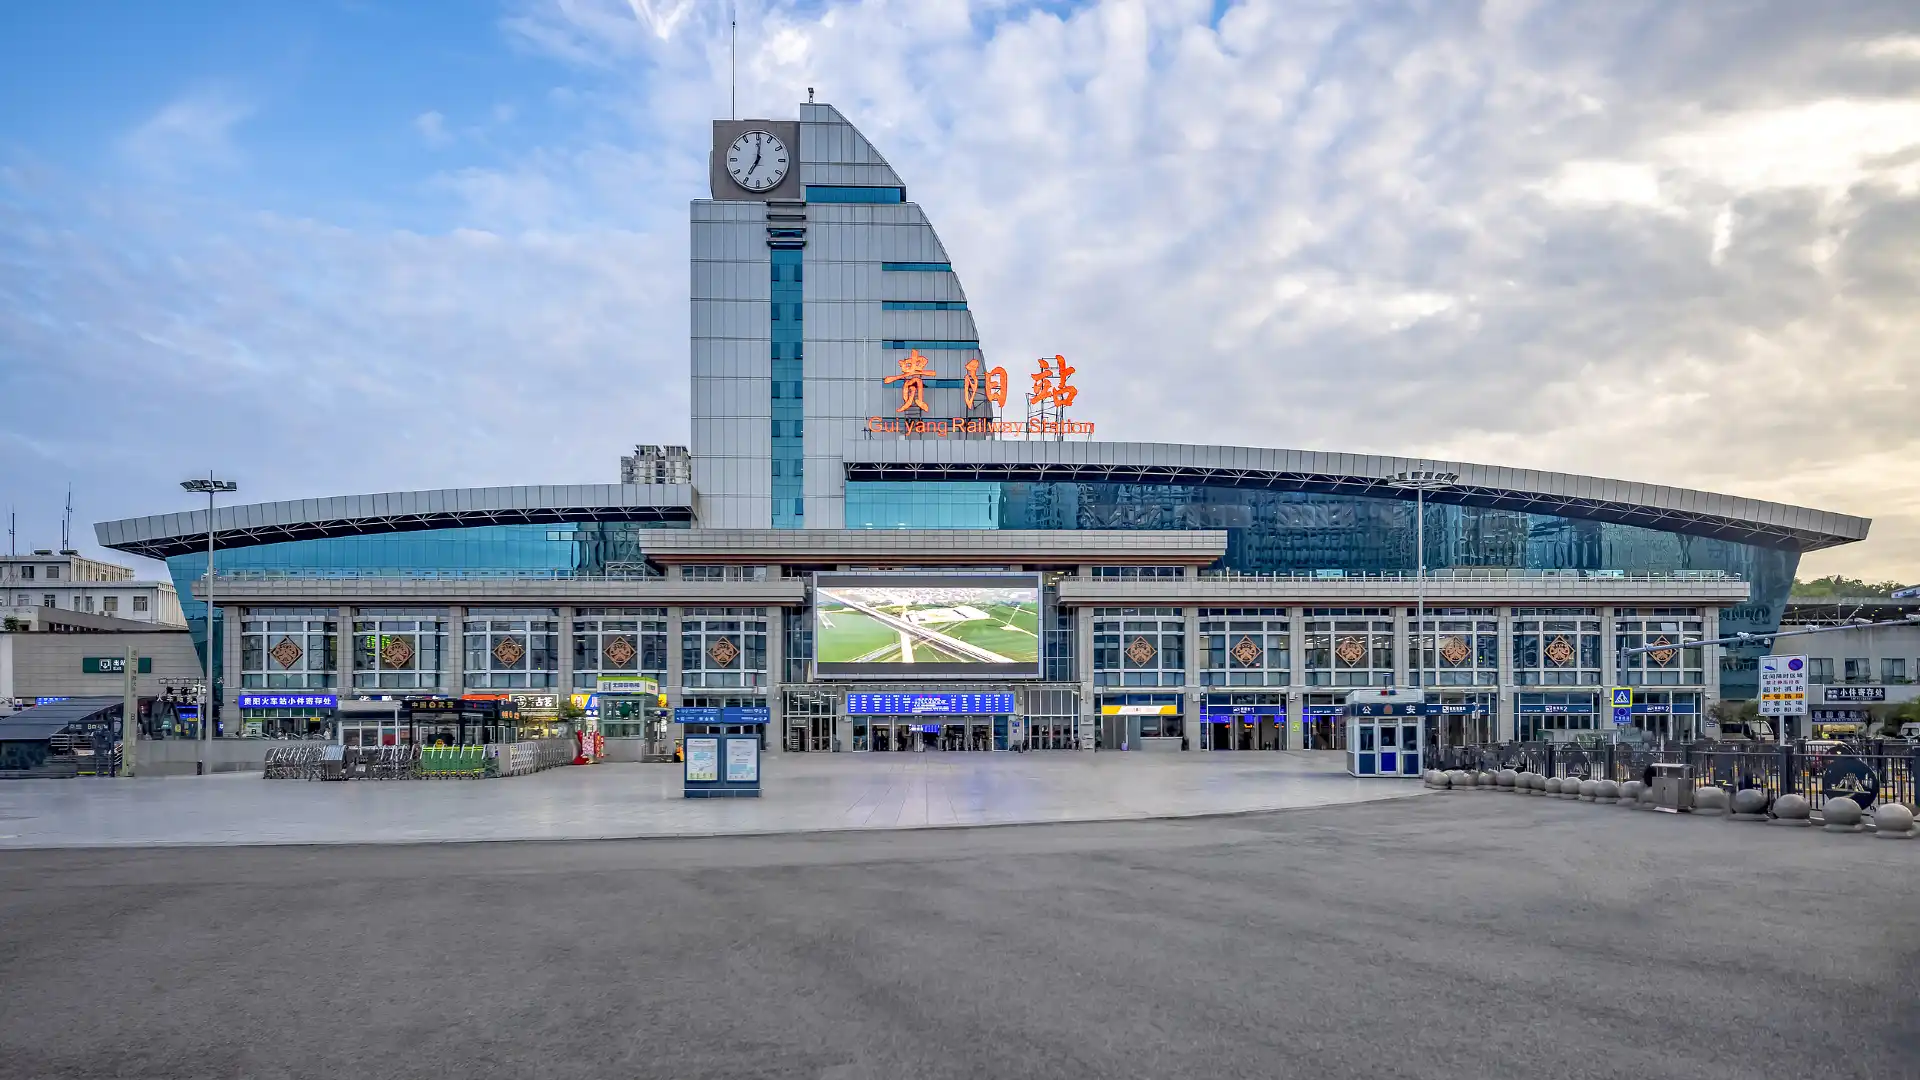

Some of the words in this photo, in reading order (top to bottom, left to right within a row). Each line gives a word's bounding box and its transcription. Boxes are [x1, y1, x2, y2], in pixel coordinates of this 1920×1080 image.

[883, 349, 1079, 413] 贵阳站
[868, 417, 900, 434] Gui
[905, 418, 948, 438] yang
[952, 417, 1024, 438] Railway
[1028, 417, 1096, 435] Station
[243, 697, 332, 706] 贵阳火车站小件寄存处
